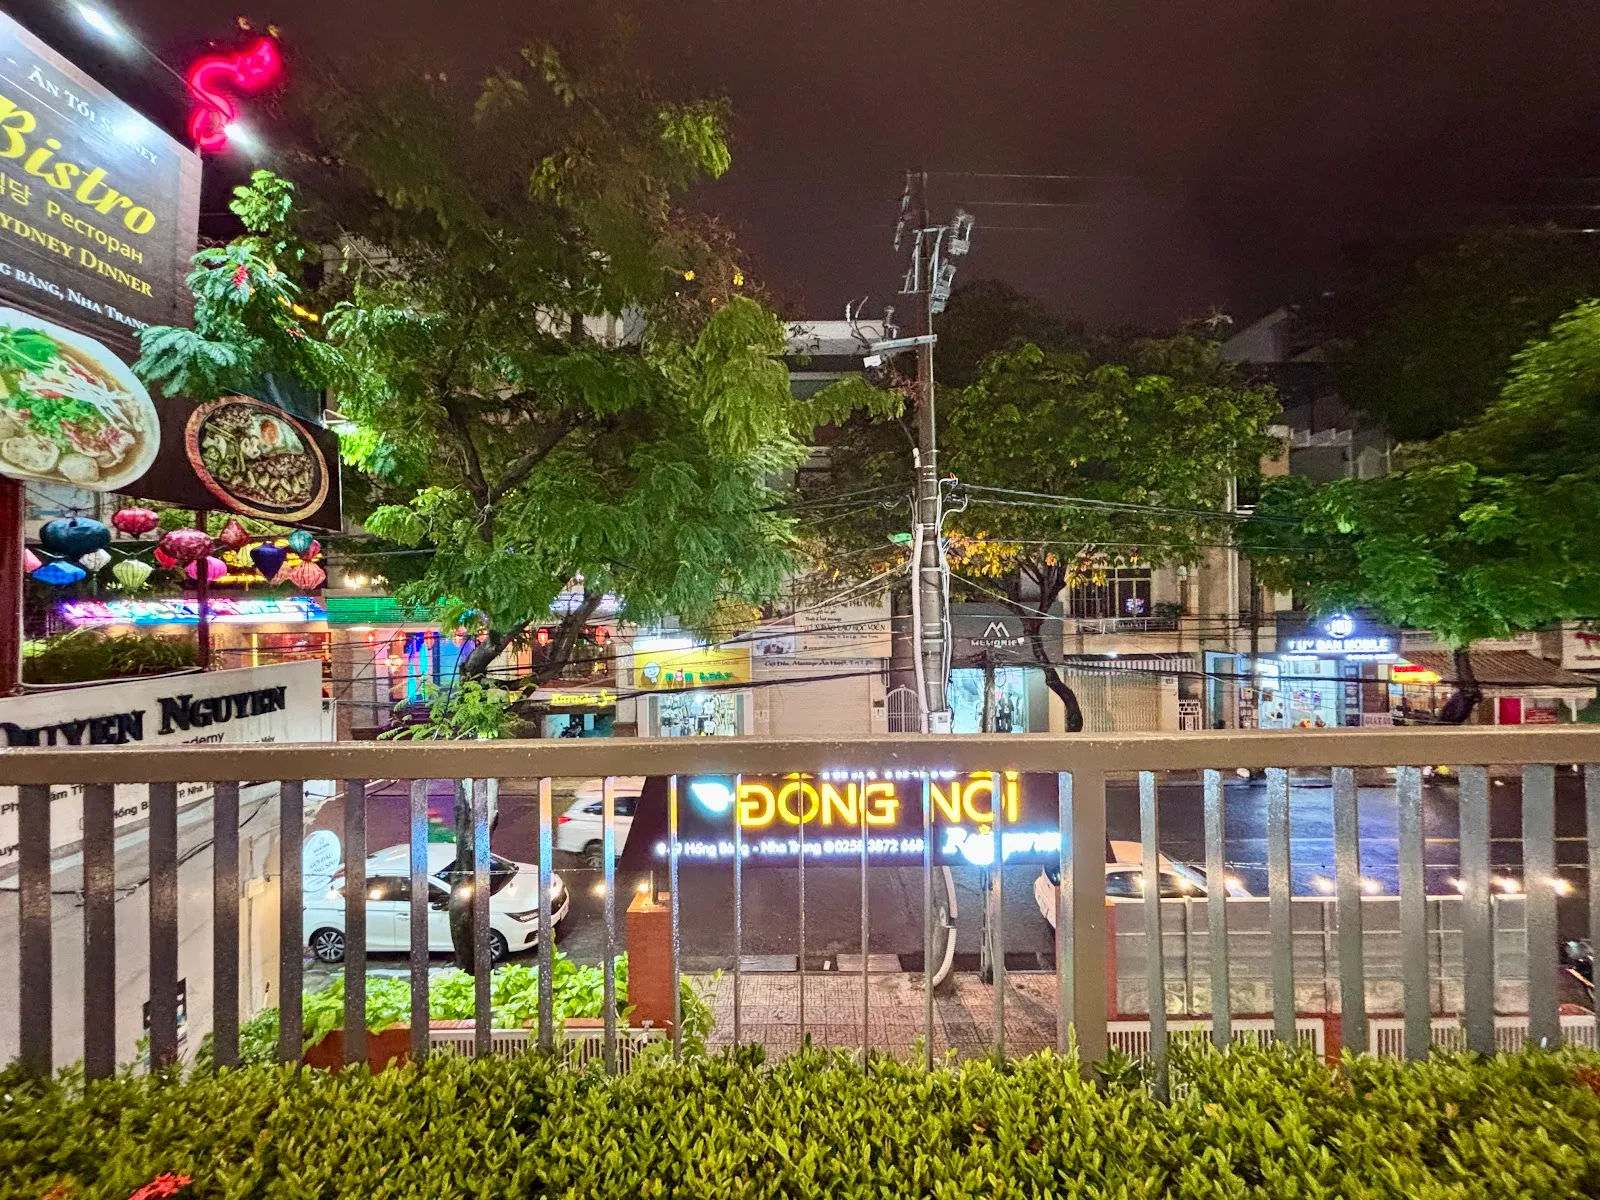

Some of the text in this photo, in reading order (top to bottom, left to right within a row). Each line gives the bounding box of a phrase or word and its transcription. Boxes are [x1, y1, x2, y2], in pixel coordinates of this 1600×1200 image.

[0, 94, 156, 235] Bistro
[46, 200, 144, 264] Ресторан
[80, 248, 153, 298] DINNER
[157, 686, 287, 735] NGUYEN
[183, 732, 225, 743] demy
